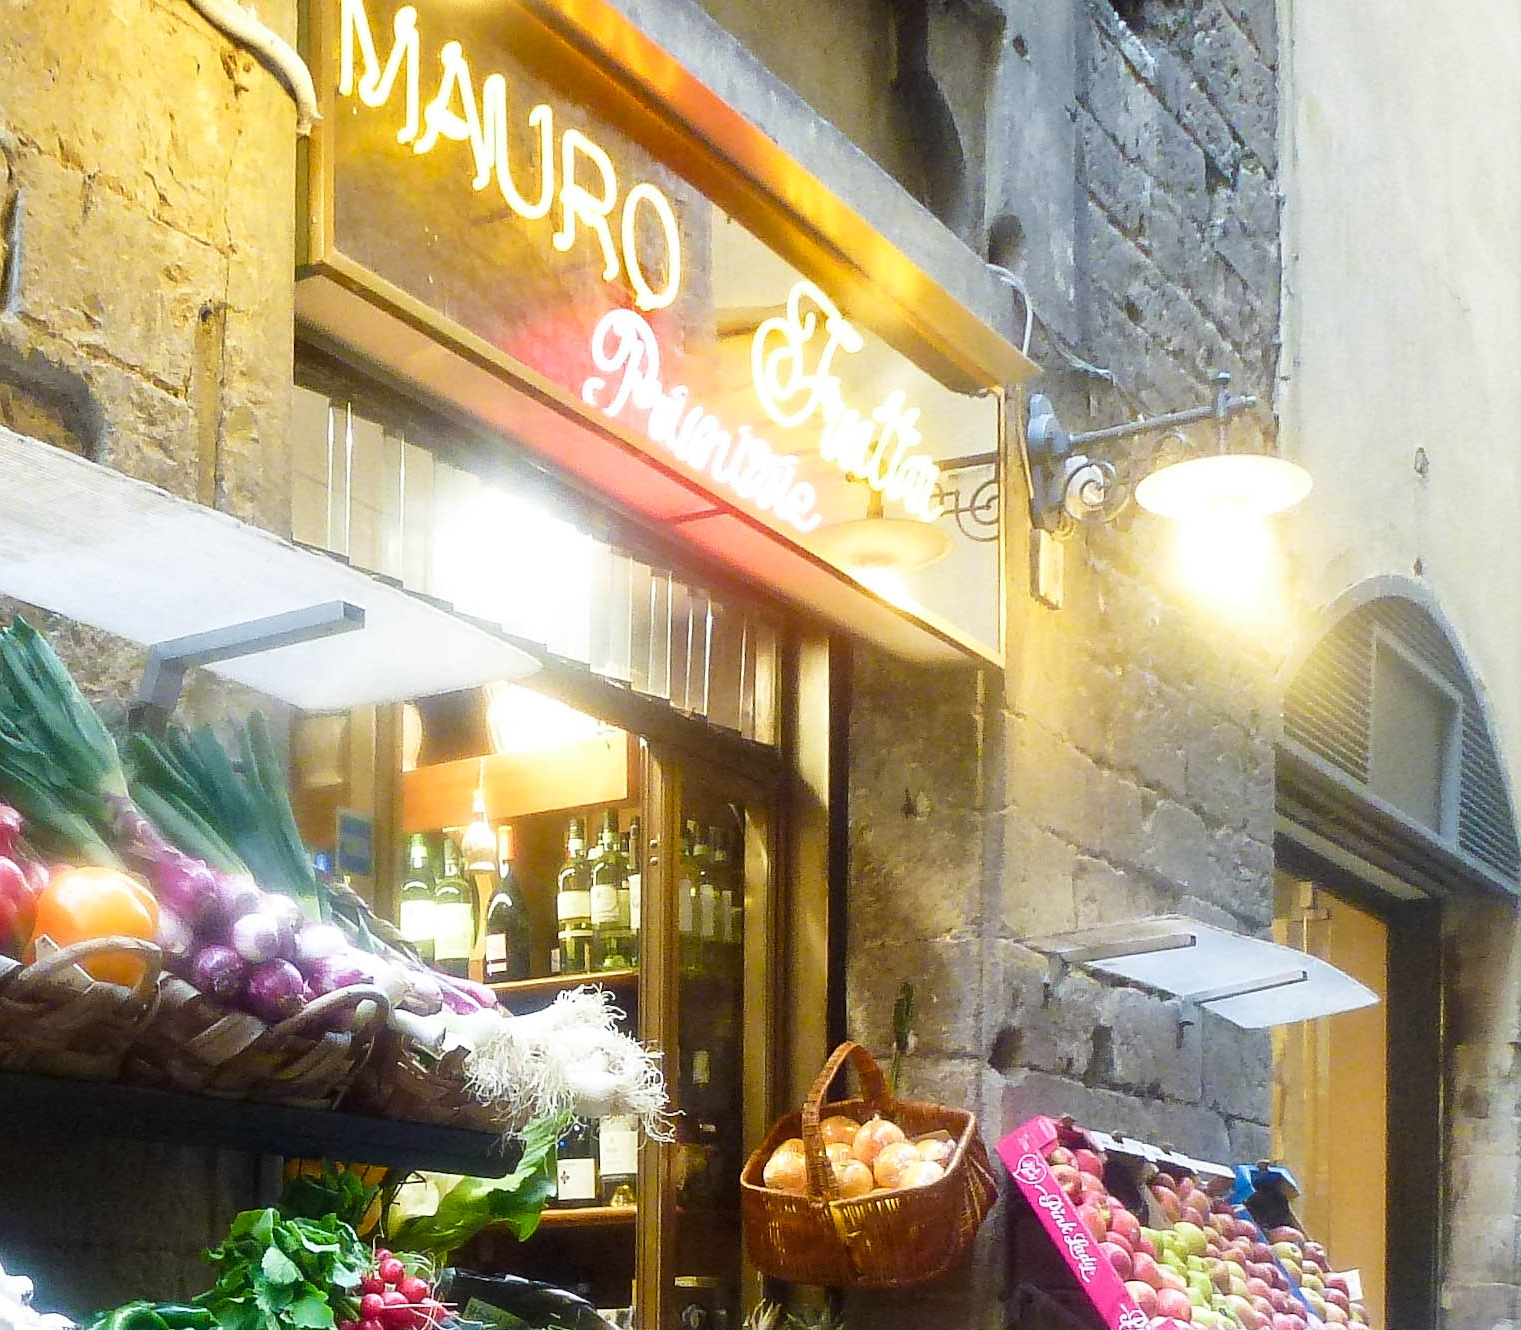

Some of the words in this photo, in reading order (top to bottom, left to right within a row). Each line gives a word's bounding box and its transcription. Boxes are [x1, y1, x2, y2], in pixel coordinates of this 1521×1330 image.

[337, 0, 681, 311] MAURO
[1035, 1185, 1078, 1239] Pink
[1064, 1232, 1097, 1283] Lady
